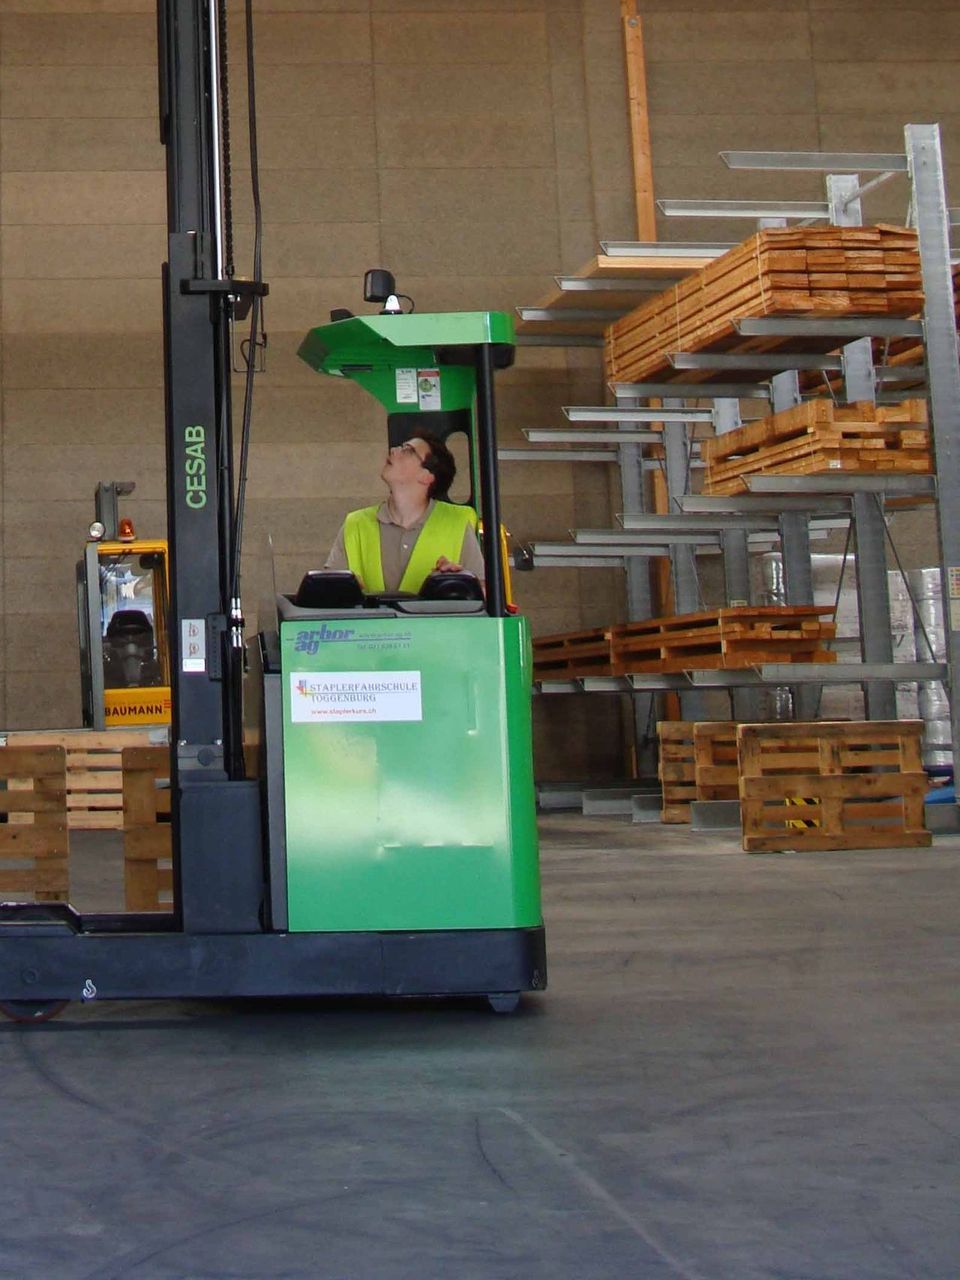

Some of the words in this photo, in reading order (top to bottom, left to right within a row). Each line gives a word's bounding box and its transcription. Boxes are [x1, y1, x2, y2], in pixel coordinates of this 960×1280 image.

[185, 425, 207, 509] CESAB
[297, 624, 355, 640] arbor
[295, 640, 320, 655] ag
[310, 682, 418, 692] STAPLERFAHRSCHULE
[311, 693, 376, 703] TOGGENBURG
[104, 704, 162, 717] BAUMANN
